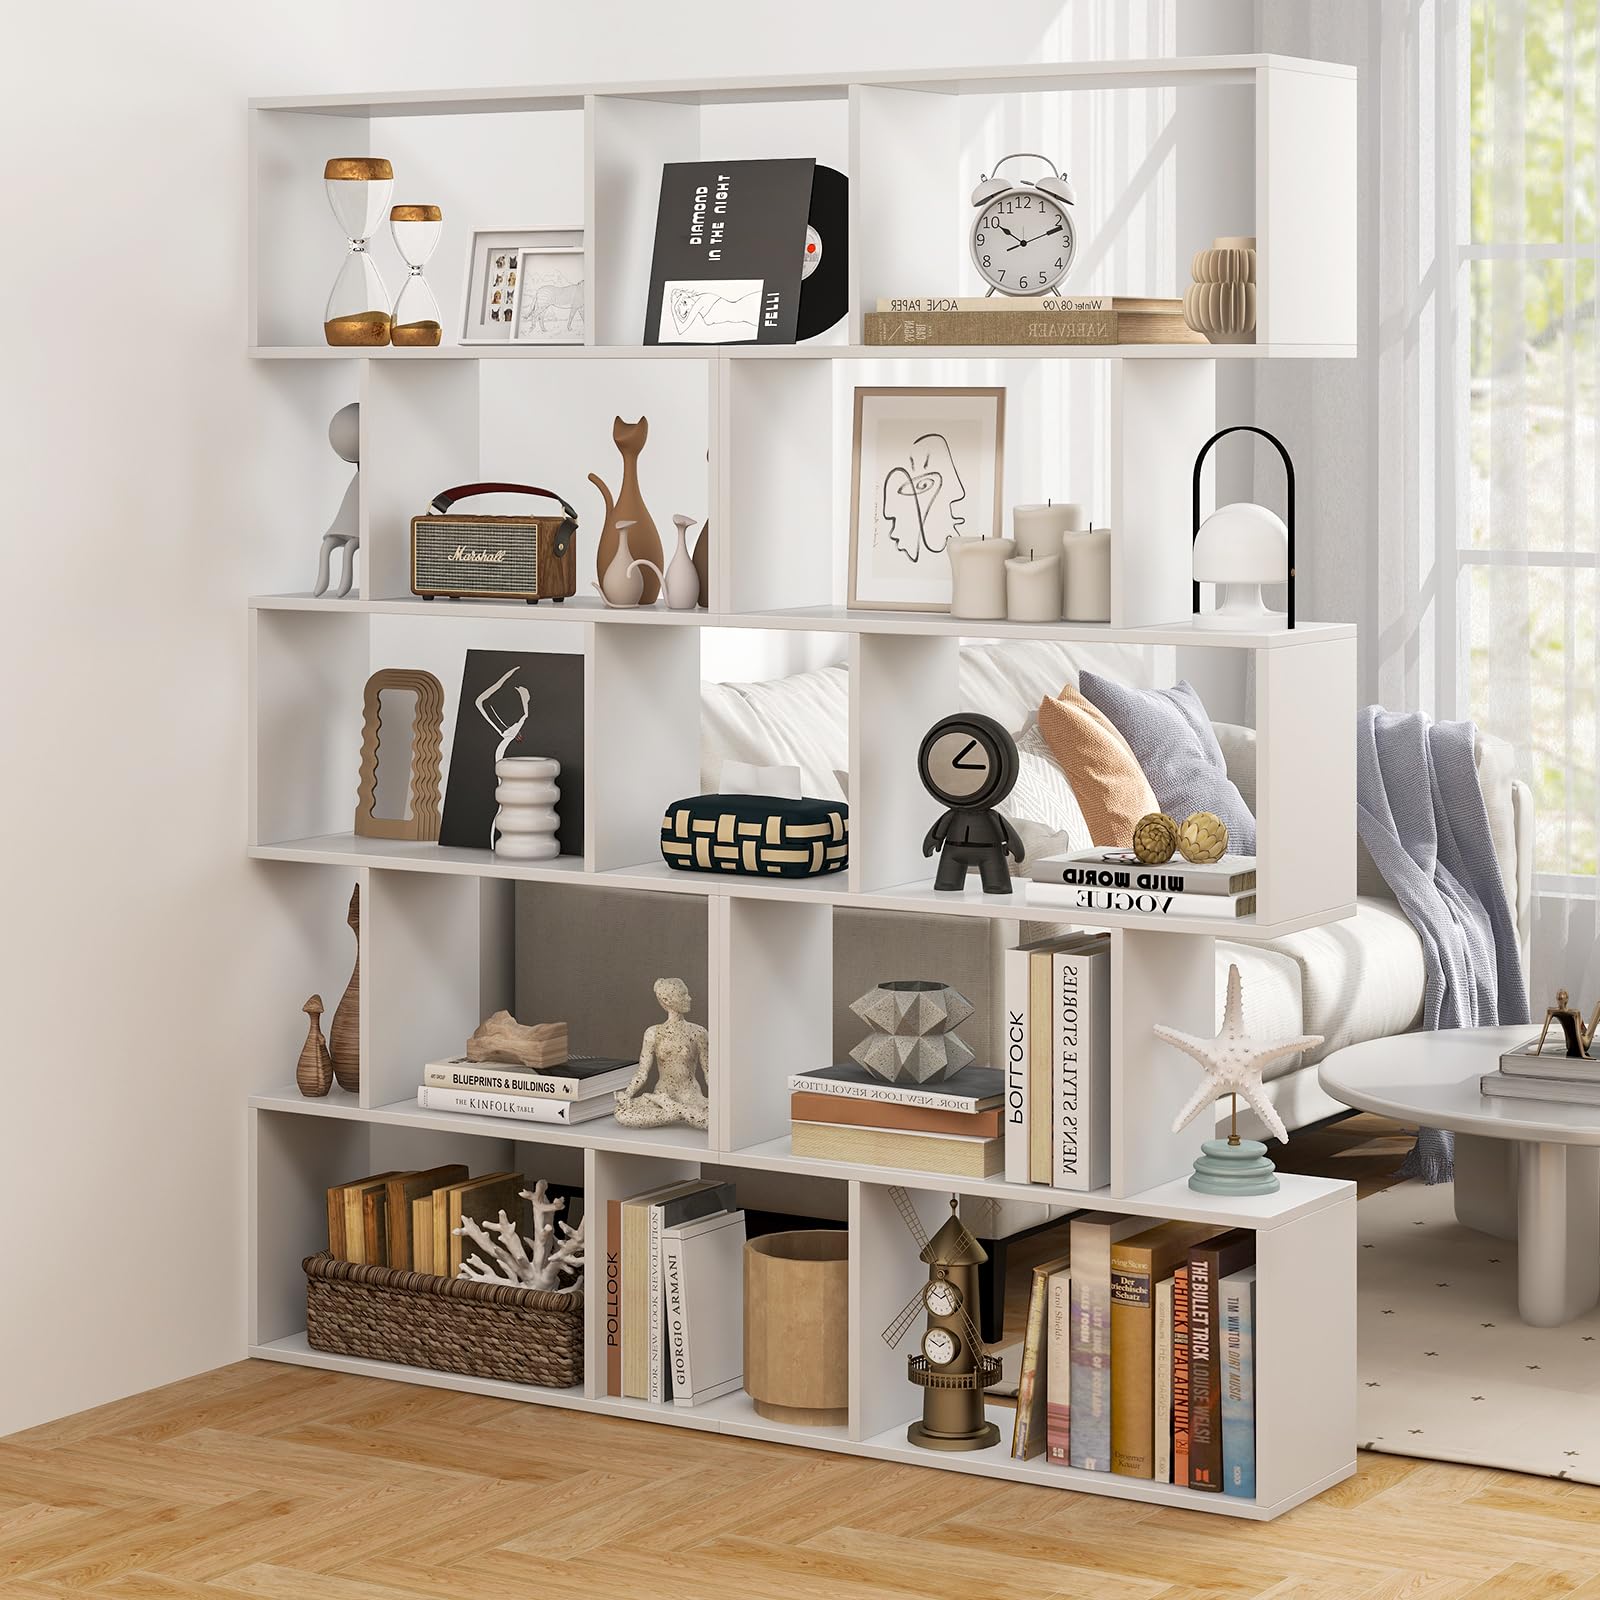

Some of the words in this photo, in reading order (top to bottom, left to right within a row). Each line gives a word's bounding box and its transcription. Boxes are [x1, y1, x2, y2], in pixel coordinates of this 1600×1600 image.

[997, 202, 1014, 214] 11
[1015, 196, 1031, 208] 12
[1038, 200, 1046, 213] 1
[983, 216, 1000, 228] 10
[1054, 214, 1062, 227] 2
[710, 222, 724, 244] THE
[976, 234, 985, 246] 9
[1062, 236, 1070, 248] 3
[982, 255, 991, 268] 8
[1054, 257, 1063, 270] 4
[998, 270, 1006, 282] 7
[1019, 276, 1028, 288] 6
[1039, 272, 1047, 284] 5
[764, 292, 780, 327] FELLI
[448, 545, 506, 562] Marshall
[452, 1074, 502, 1088] BLUEPRINTS
[504, 1078, 510, 1089] &
[512, 1079, 555, 1093] BUILDINGS
[470, 1098, 516, 1113] KINFOLK
[1191, 1261, 1208, 1283] THE
[668, 1254, 680, 1315] ARMANI
[1120, 1276, 1135, 1286] Der
[607, 1252, 618, 1346] POLLOCK
[1192, 1284, 1209, 1325] BULLET
[1227, 1297, 1240, 1312] TIM
[1228, 1316, 1240, 1349] WINTON
[1192, 1328, 1210, 1360] TRICK
[673, 1320, 686, 1385] GIORGIO
[1193, 1362, 1210, 1401] LOUISE
[1193, 1405, 1210, 1443] WELSH
